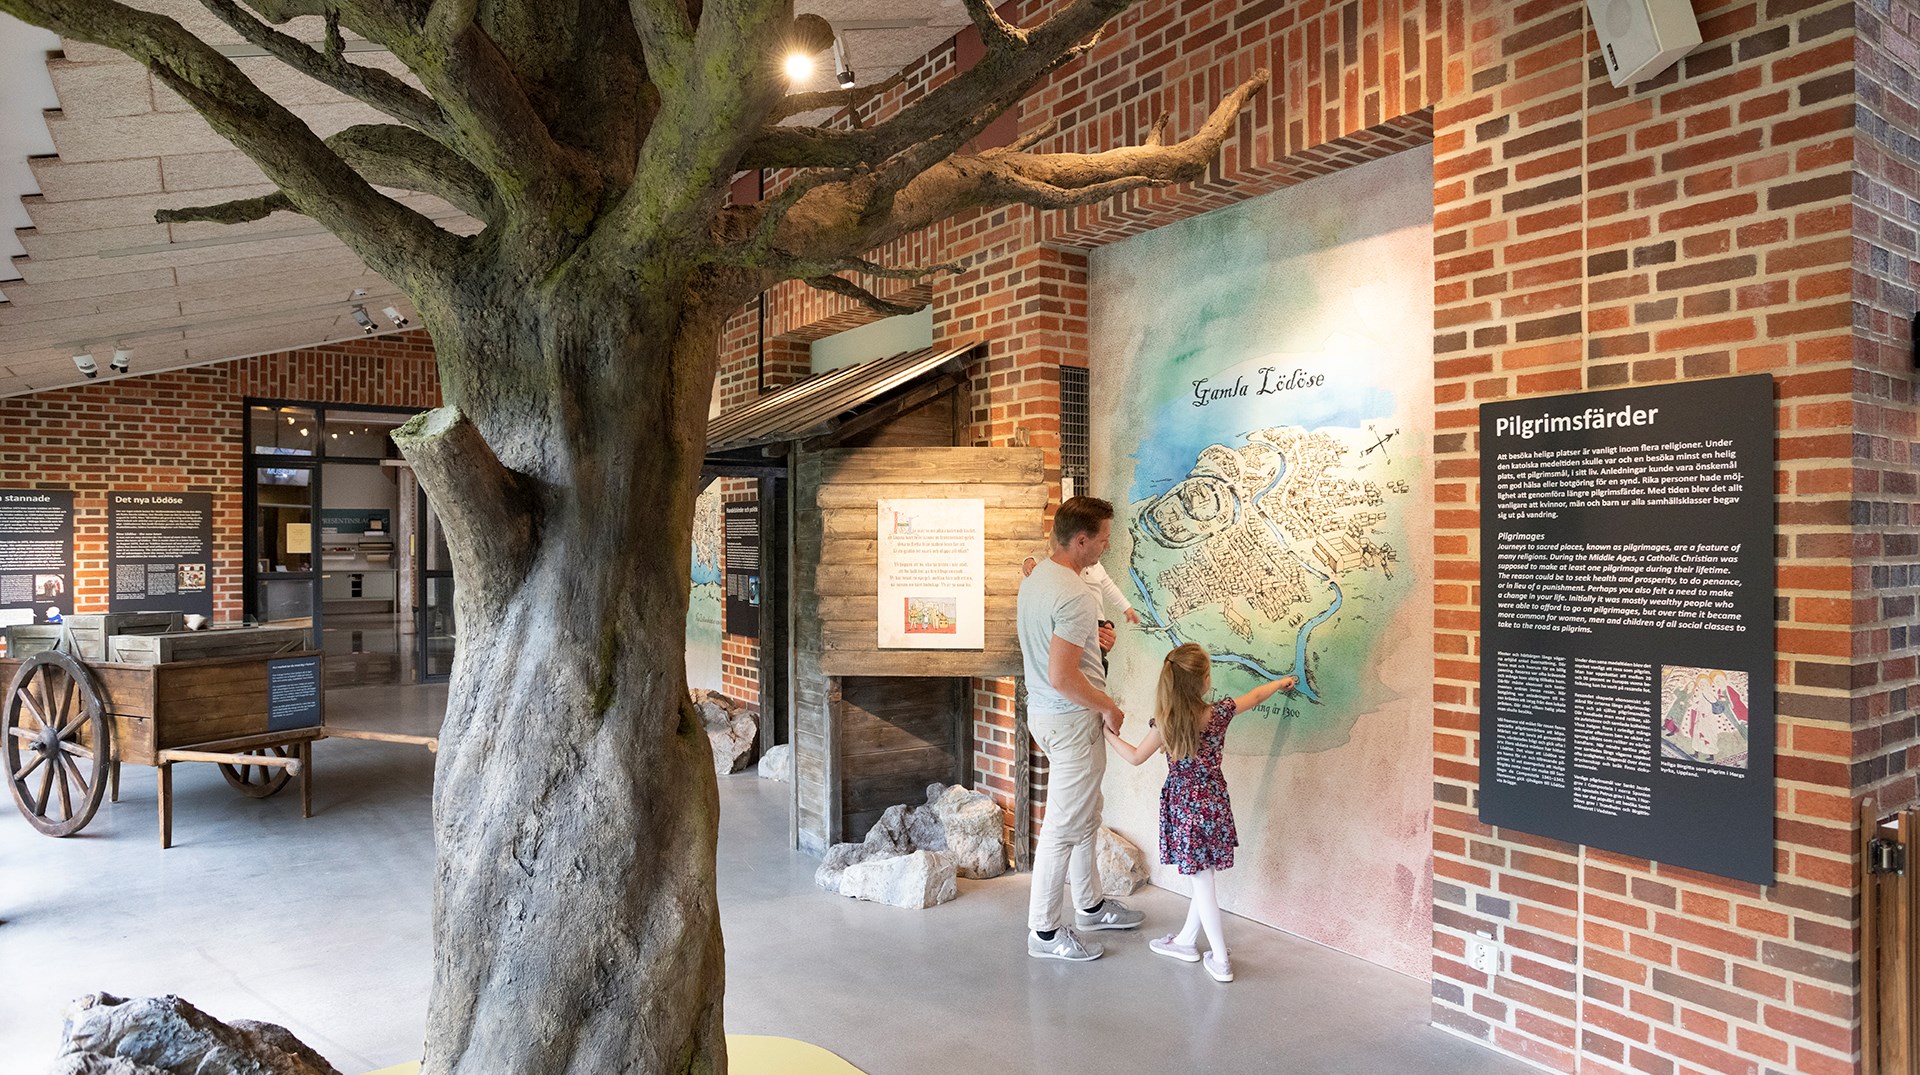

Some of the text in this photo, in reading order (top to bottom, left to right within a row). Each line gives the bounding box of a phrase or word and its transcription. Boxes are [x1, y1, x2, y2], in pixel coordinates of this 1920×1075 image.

[1191, 366, 1325, 408] Gamla Lödöse
[1496, 405, 1659, 439] Pilgrimsfärder
[1509, 452, 1532, 460] besöka
[1534, 451, 1554, 459] heliga
[1556, 449, 1581, 458] platser
[1592, 446, 1617, 455] vanligt
[1661, 442, 1703, 451] religioner.
[1705, 439, 1733, 447] Under
[1512, 450, 1736, 469] katolska medeltiden skulle besöka minst helig
[1497, 473, 1515, 481] plats,
[1528, 470, 1570, 480] pilgrimsmål,
[1600, 466, 1647, 475] Anledningar
[1649, 464, 1674, 472] kunde
[1695, 461, 1737, 470] önskemål
[1509, 482, 1522, 490] god
[1560, 479, 1594, 488] botgöring
[1620, 477, 1640, 486] synd.
[1642, 476, 1659, 484] Rika
[1661, 476, 1698, 485] personer
[1700, 473, 1721, 481] hade
[1723, 472, 1744, 482] möj-
[1498, 484, 1742, 500] lighet genomföra längre pilgrimsfärder. Med tiden blev allt
[4, 495, 51, 503] stannade
[115, 496, 183, 505] Det nya Lödöse
[1497, 502, 1527, 510] vanligare
[1647, 497, 1712, 505] samhällsklasser
[1713, 496, 1740, 505] begav
[1498, 511, 1558, 520] sig vandring.
[1498, 532, 1545, 542] Pilgrimages
[1497, 543, 1526, 551] Journeys
[1560, 543, 1584, 551] places,
[1623, 543, 1672, 552] pilgrimages,
[1696, 543, 1729, 552] feature
[1517, 553, 1548, 561] religions.
[1550, 554, 1574, 562] During
[1616, 554, 1637, 563] Ages,
[1646, 554, 1679, 562] Catholic
[1681, 554, 1718, 562] Christian
[1498, 563, 1529, 571] supposed
[1602, 564, 1644, 574] pilgrimage
[1646, 565, 1672, 574] during
[1674, 565, 1694, 573] their
[1695, 566, 1731, 575] lifetime.
[1592, 574, 1617, 582] health
[1634, 576, 1677, 585] prosperity,
[1702, 579, 1742, 587] penance,
[1587, 585, 1617, 594] Perhaps
[1635, 586, 1651, 594] also
[1652, 587, 1667, 595] felt
[1709, 589, 1733, 597] make
[1503, 592, 1528, 600] change
[1554, 594, 1567, 602] life.
[1569, 594, 1596, 604] Initially
[1621, 597, 1648, 606] mostly
[1649, 598, 1683, 607] wealthy
[1683, 600, 1713, 608] people
[1715, 600, 1734, 608] who
[1540, 603, 1562, 611] afford
[1593, 606, 1640, 616] pilgrimages,
[1678, 610, 1697, 618] time
[1707, 611, 1742, 620] became
[1559, 616, 1587, 624] women,
[1623, 618, 1654, 626] children
[1678, 621, 1703, 629] social
[1704, 622, 1734, 631] classes
[1561, 625, 1592, 633] pilgrims.
[1272, 703, 1281, 715] år
[1282, 707, 1300, 719] 1300
[1101, 912, 1117, 924] N
[1053, 944, 1071, 957] N
